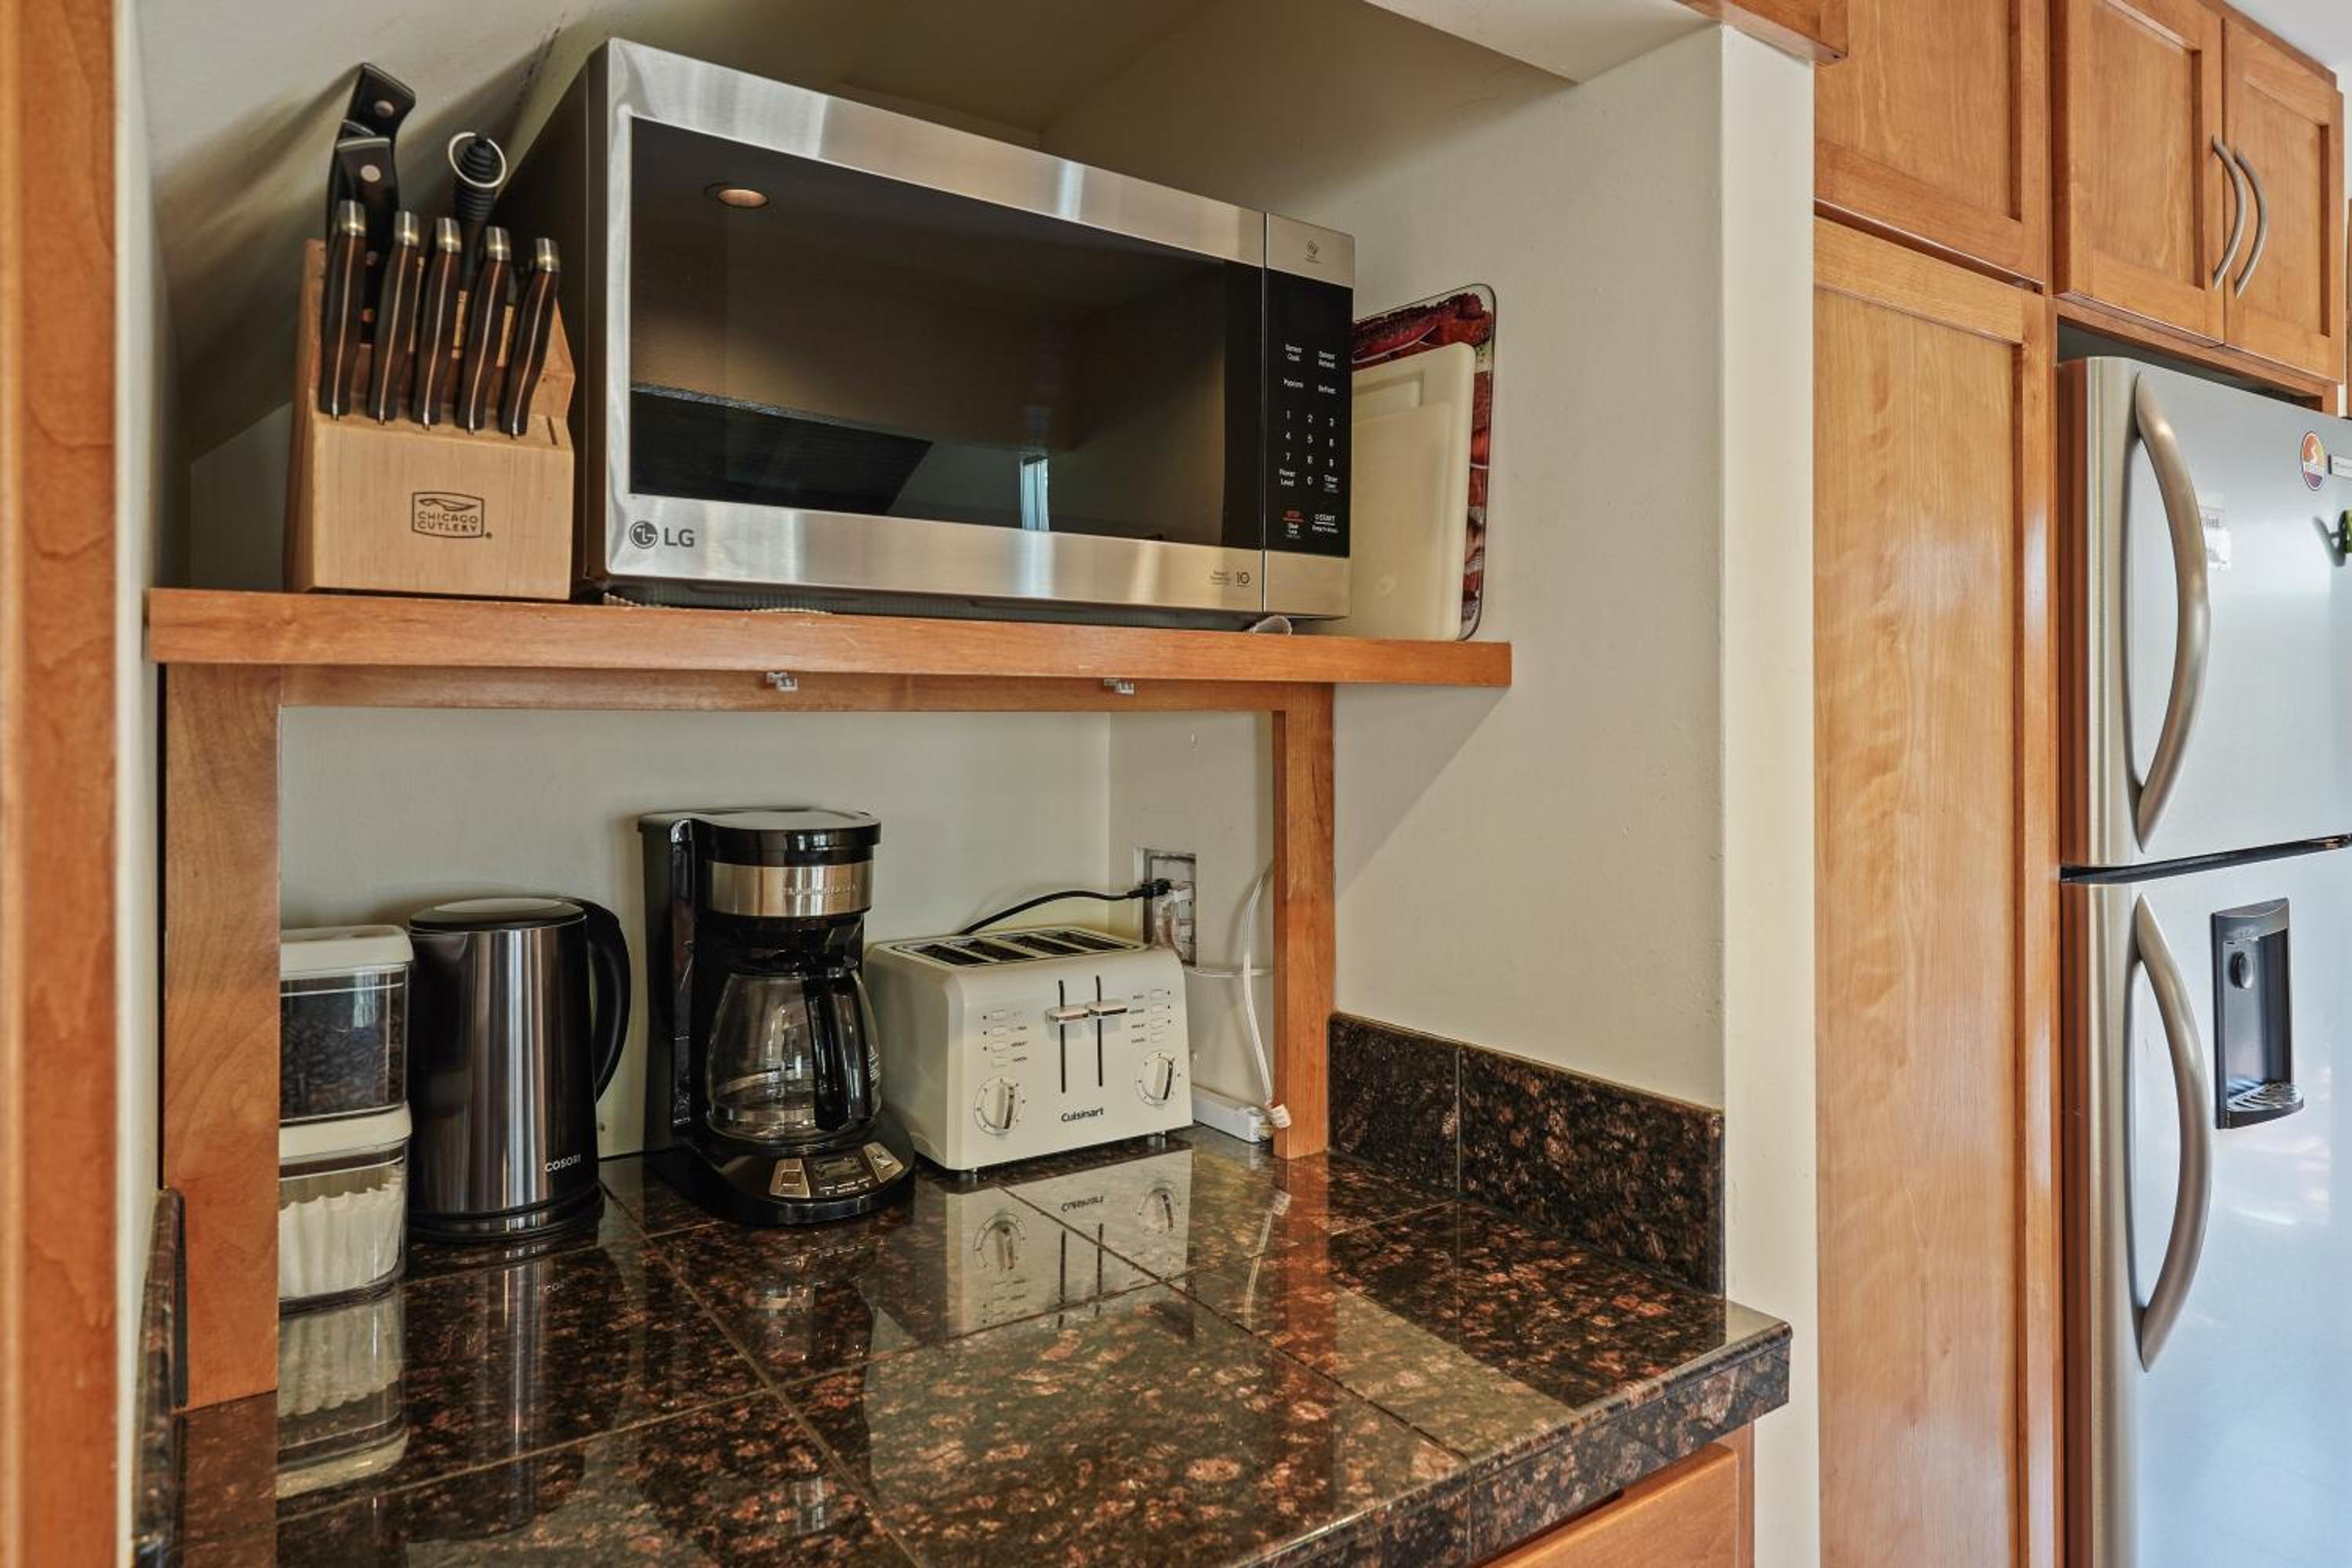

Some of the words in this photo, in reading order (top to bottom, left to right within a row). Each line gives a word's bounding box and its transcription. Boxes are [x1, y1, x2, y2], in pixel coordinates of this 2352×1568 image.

[417, 510, 479, 524] CHICAGO
[417, 520, 477, 532] CUTLERY
[664, 527, 695, 548] LG
[1060, 1106, 1105, 1123] Cuisinart
[544, 1153, 581, 1172] COSORI
